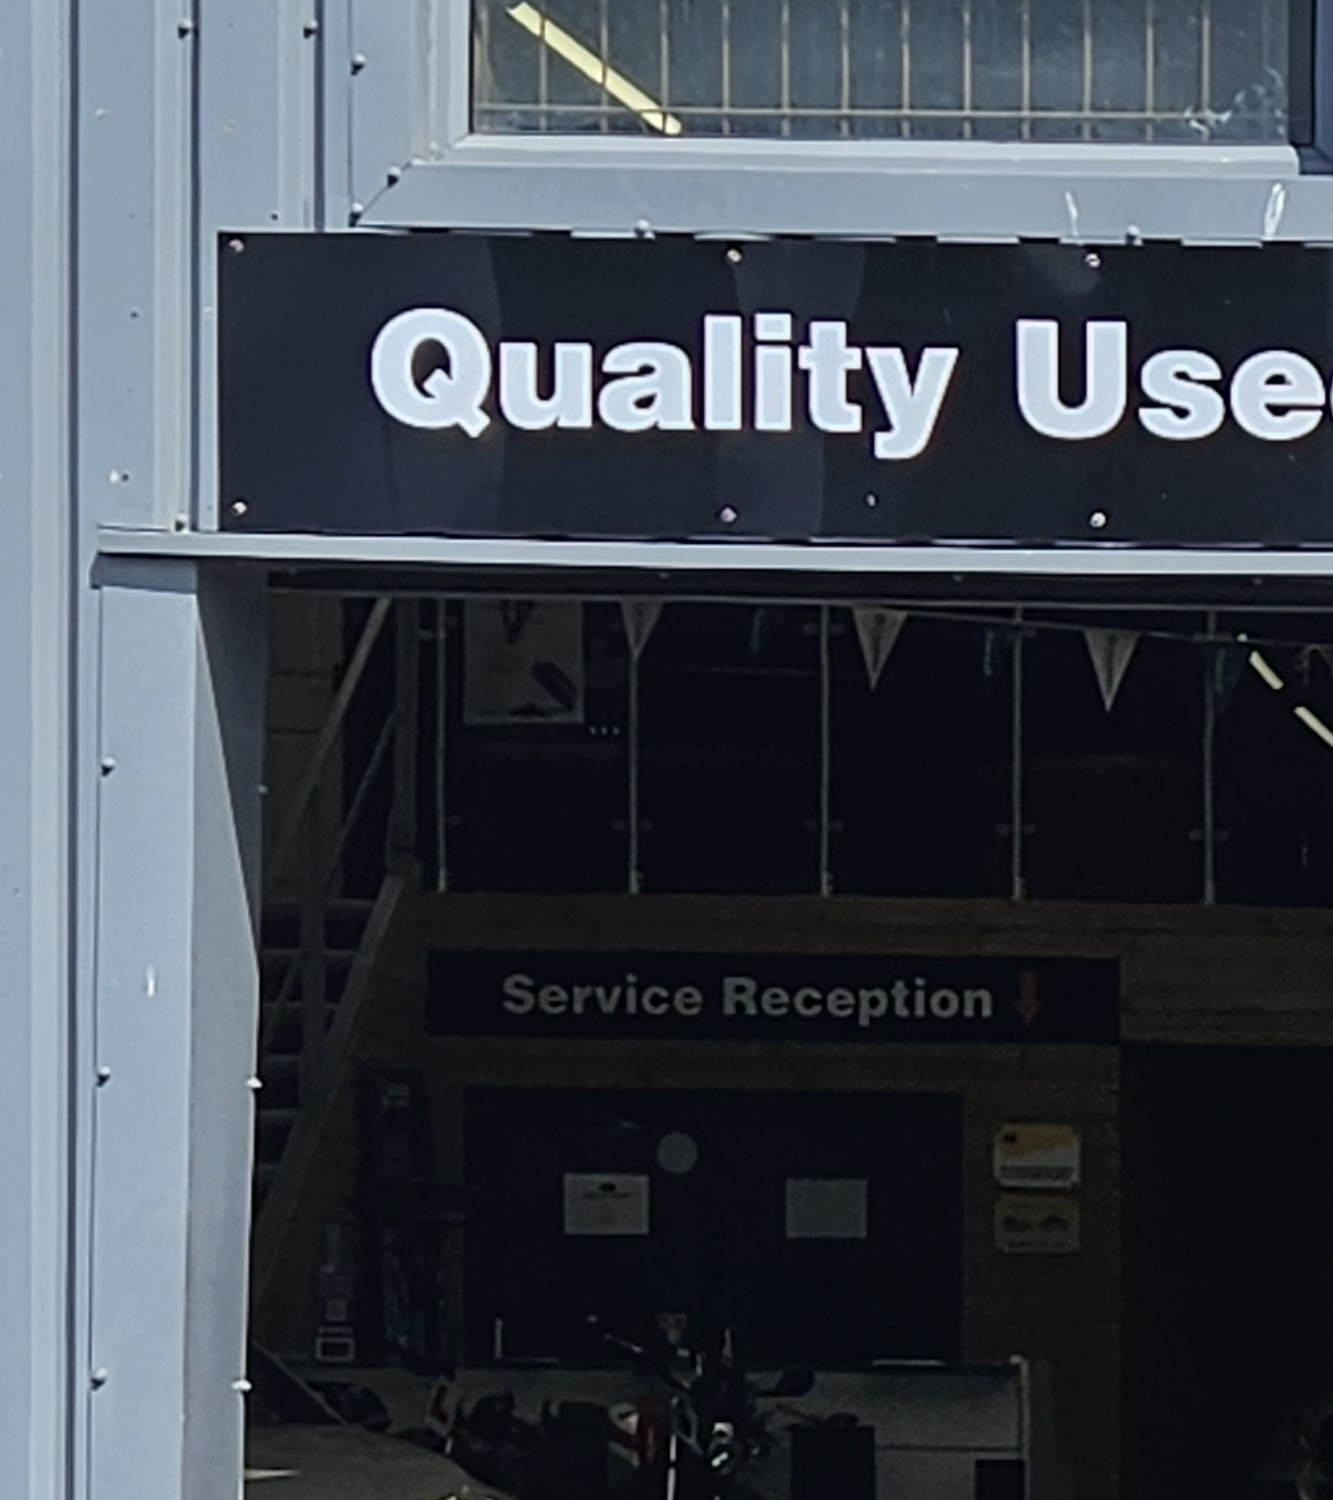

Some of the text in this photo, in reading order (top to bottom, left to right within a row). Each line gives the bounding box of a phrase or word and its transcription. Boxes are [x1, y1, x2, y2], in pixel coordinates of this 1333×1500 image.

[371, 308, 959, 460] Quality
[501, 973, 995, 1028] Service Reception
